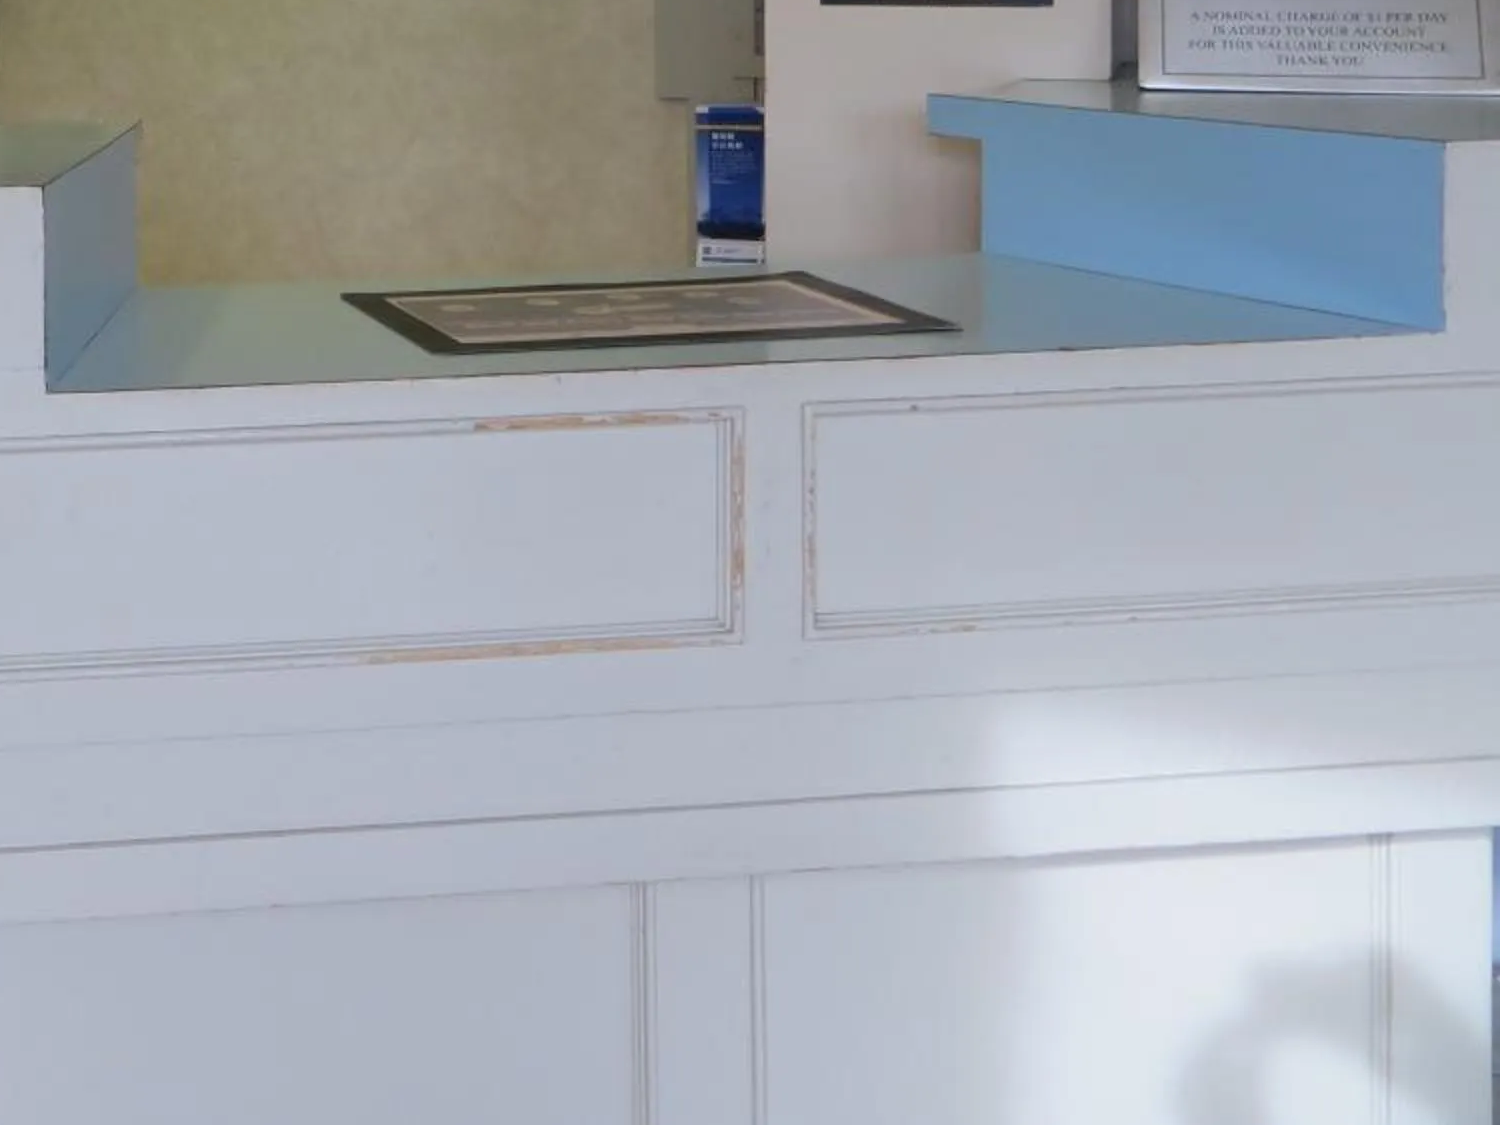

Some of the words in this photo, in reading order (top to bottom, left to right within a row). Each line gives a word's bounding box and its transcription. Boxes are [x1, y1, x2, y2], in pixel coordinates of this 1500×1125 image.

[1191, 12, 1200, 21] A
[1204, 11, 1270, 21] NOMINAL
[1276, 12, 1338, 22] CHARGE
[1343, 13, 1359, 22] OF
[1386, 13, 1413, 22] PER
[1417, 13, 1447, 23] DAY
[1213, 26, 1225, 36] IS
[1229, 26, 1281, 36] ADDED
[1286, 26, 1304, 36] TO
[1306, 26, 1349, 36] YOUR
[1354, 27, 1425, 38] ACCOUNT
[1188, 40, 1216, 50] FOR
[1222, 40, 1253, 51] THIS
[1257, 40, 1332, 52] VALUABLE
[1340, 41, 1446, 52] CONVENIENCE
[1277, 55, 1329, 65] THANK
[1334, 56, 1364, 66] YOU
